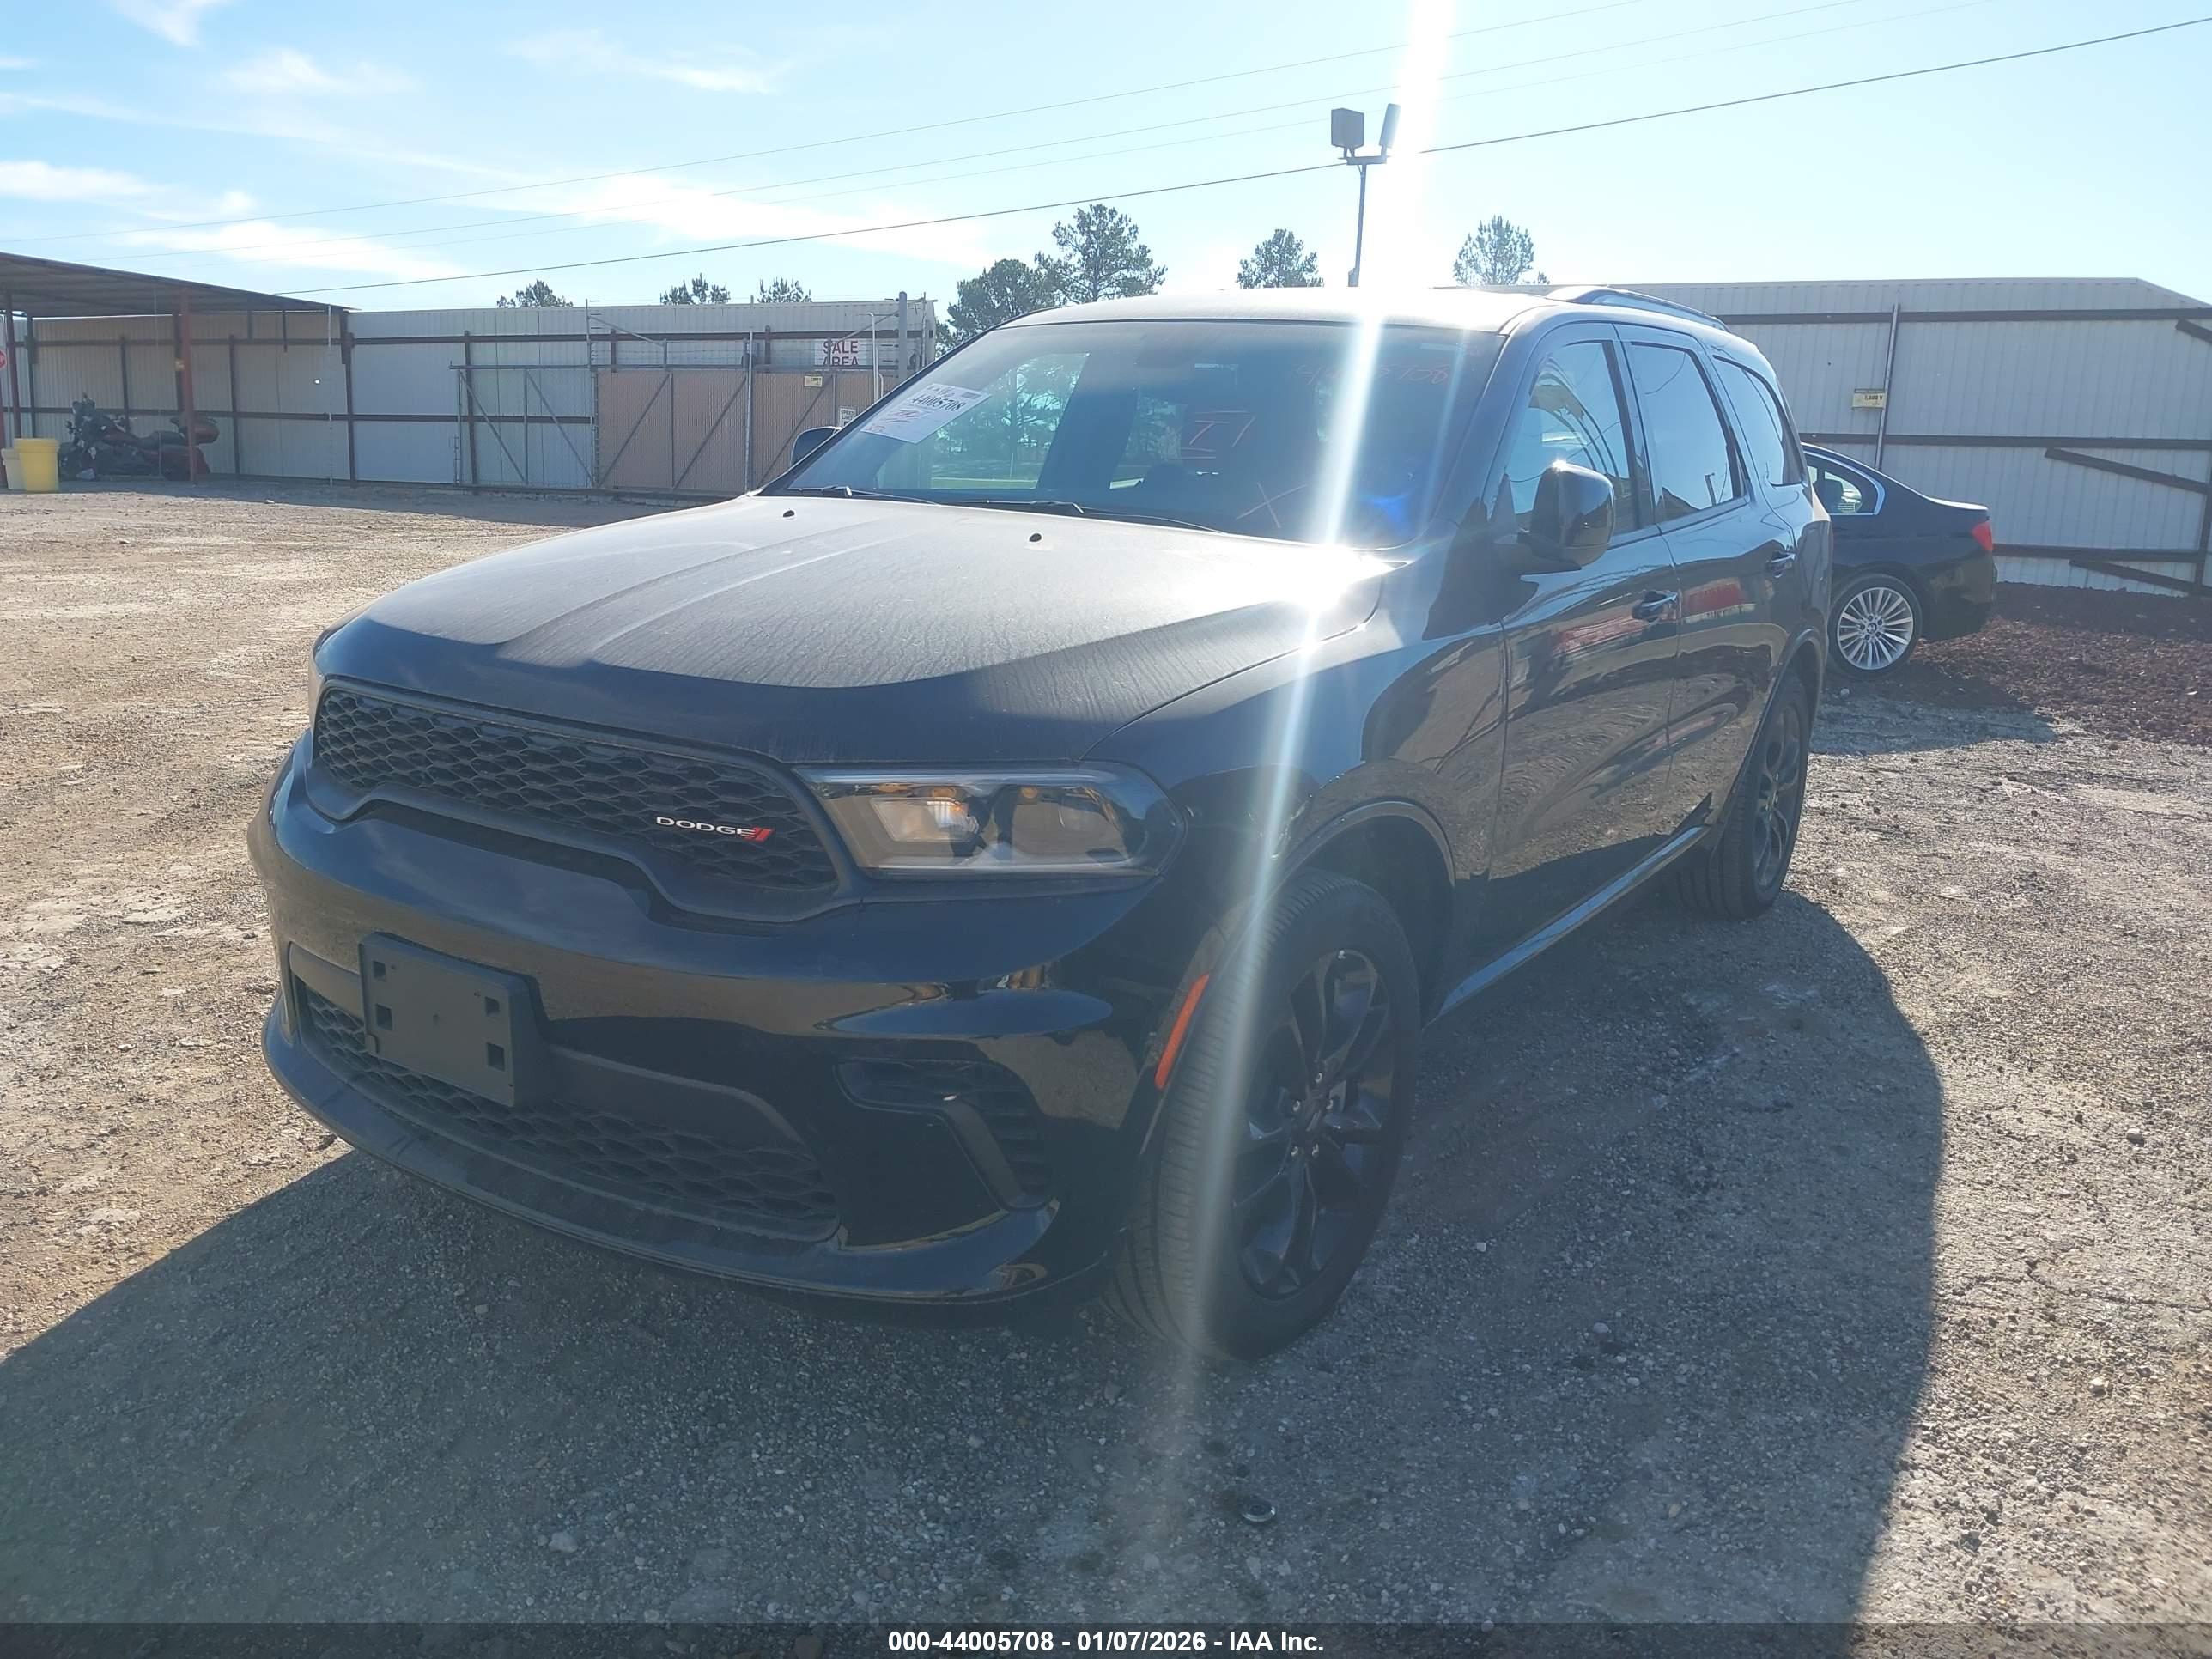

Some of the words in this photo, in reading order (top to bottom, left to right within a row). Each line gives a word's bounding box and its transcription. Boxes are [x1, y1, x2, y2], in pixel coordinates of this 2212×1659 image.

[823, 340, 858, 354] SALE
[823, 356, 858, 366] AREA
[912, 394, 967, 411] 44005708
[656, 817, 757, 838] DODGE
